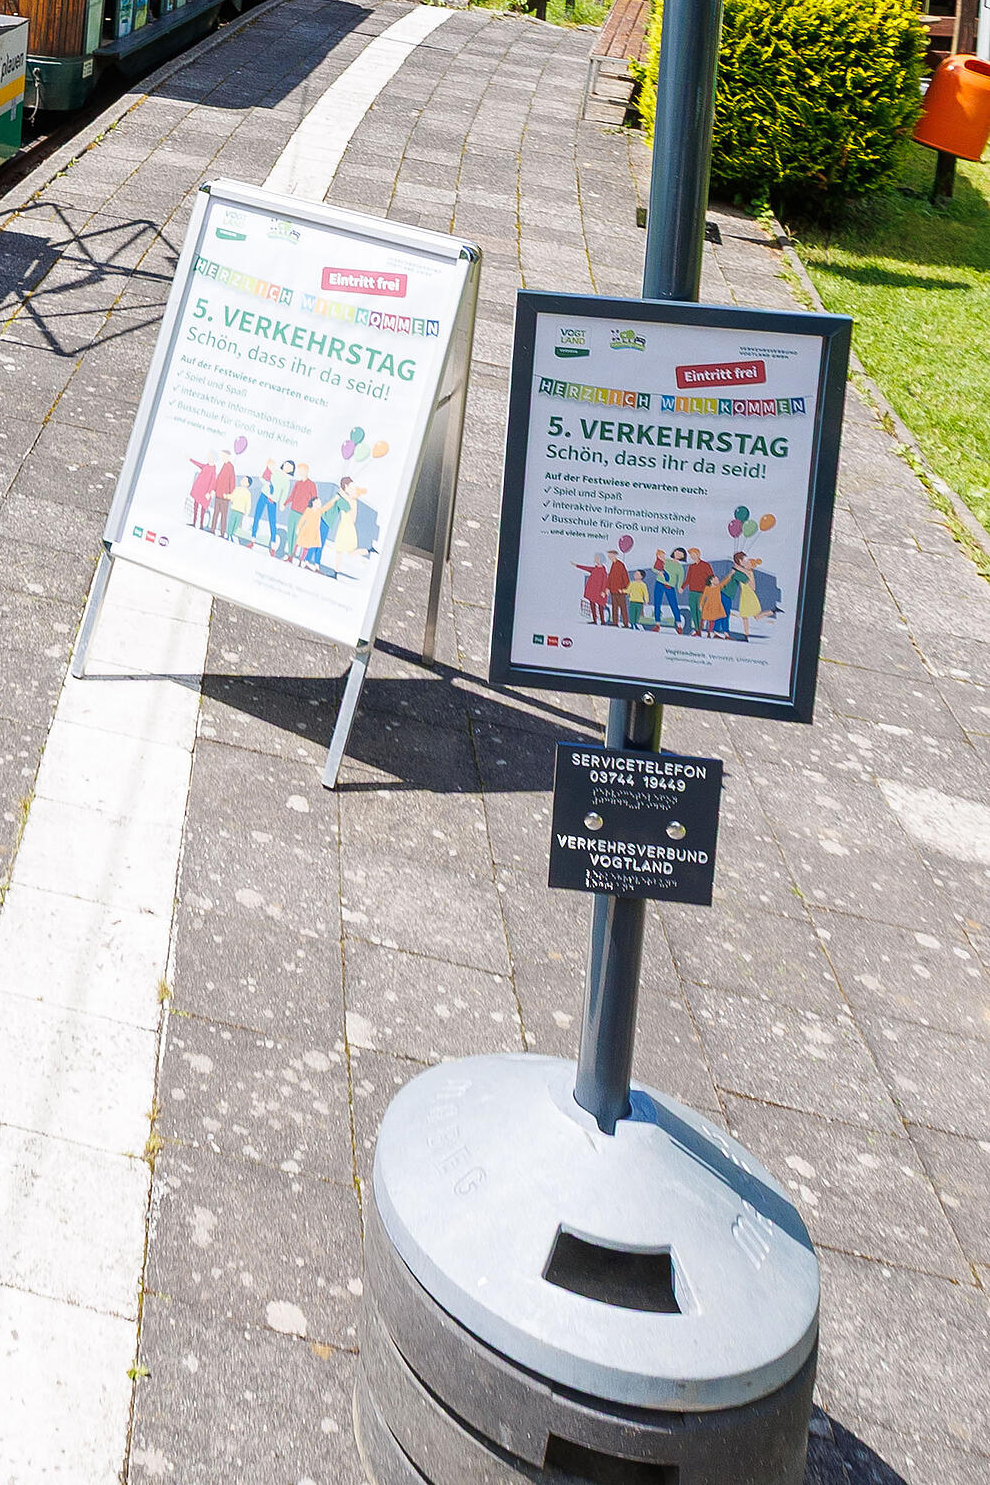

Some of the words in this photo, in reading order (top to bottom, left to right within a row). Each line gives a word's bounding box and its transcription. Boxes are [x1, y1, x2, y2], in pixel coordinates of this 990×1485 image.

[1, 53, 24, 83] plauen
[329, 272, 376, 291] Eintritt
[376, 275, 400, 291] frei
[196, 258, 294, 305] HERZLICH
[302, 295, 440, 336] WILLKOMMEN
[193, 298, 213, 322] 5.
[224, 305, 416, 382] VERKEHRSTAG
[560, 328, 587, 337] VOGT
[560, 336, 586, 345] LAND
[180, 354, 195, 365] Auf
[197, 359, 211, 370] der
[214, 364, 258, 385] Festwiese
[258, 379, 301, 399] erwarten
[186, 326, 242, 359] Schön,
[248, 345, 286, 369] dass
[291, 357, 316, 378] ihr
[320, 367, 341, 387] da
[346, 377, 392, 402] seid!
[684, 367, 733, 383] Eintritt
[734, 365, 759, 380] frei
[185, 371, 206, 385] Spiel
[207, 378, 223, 391] und
[225, 383, 248, 398] Spaß
[540, 378, 651, 410] HERZLICH
[661, 395, 806, 414] WILLKOMMEN
[257, 427, 275, 439] und
[277, 433, 299, 447] Klein
[547, 416, 572, 438] 5.
[580, 418, 789, 458] VERKEHRSTAG
[546, 444, 609, 467] Schön,
[614, 449, 657, 468] dass
[662, 453, 687, 471] ihr
[693, 455, 717, 475] da
[721, 459, 767, 479] seid!
[545, 471, 562, 481] Auf
[563, 473, 580, 483] der
[582, 475, 631, 488] Festwiese
[632, 481, 679, 494] erwarten
[681, 485, 709, 496] euch:
[552, 487, 577, 498] Spiel
[578, 489, 597, 499] und
[598, 491, 623, 502] Spaß
[552, 501, 603, 513] interaktive
[604, 505, 697, 524] Informationsstände
[550, 528, 564, 536] und
[565, 529, 586, 538] vieles
[551, 515, 598, 528] Busschule
[600, 518, 613, 529] für
[615, 521, 640, 532] Groß
[641, 524, 659, 534] und
[661, 525, 685, 536] Klein
[571, 753, 707, 780] SERVICETELEFON
[589, 770, 635, 787] 03744
[643, 775, 686, 793] 19449
[556, 833, 709, 865] VERKEHRSVERBUND
[589, 852, 673, 875] VOGTLAND
